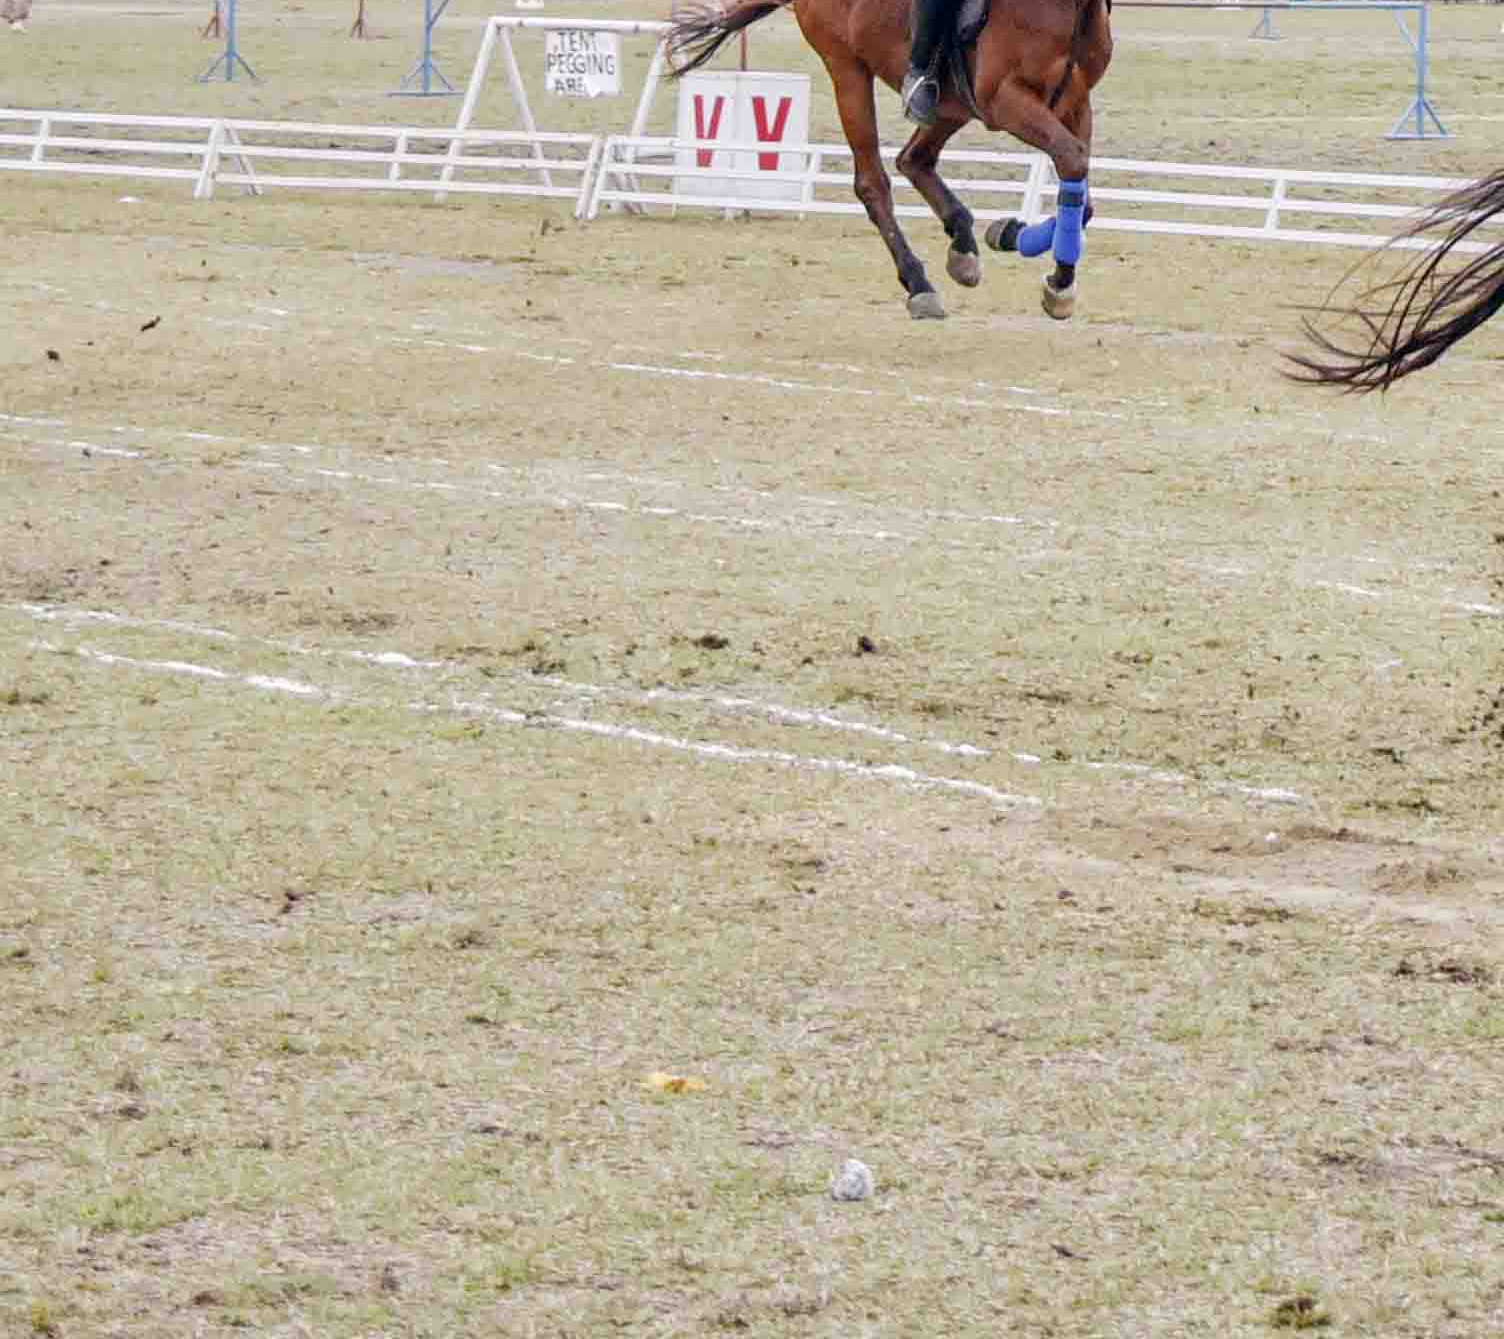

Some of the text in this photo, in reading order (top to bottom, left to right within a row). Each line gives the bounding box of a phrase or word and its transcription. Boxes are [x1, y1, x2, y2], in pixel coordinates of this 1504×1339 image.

[546, 52, 616, 75] PEGGING
[557, 31, 597, 51] TENT
[693, 94, 725, 168] V
[751, 95, 793, 171] V
